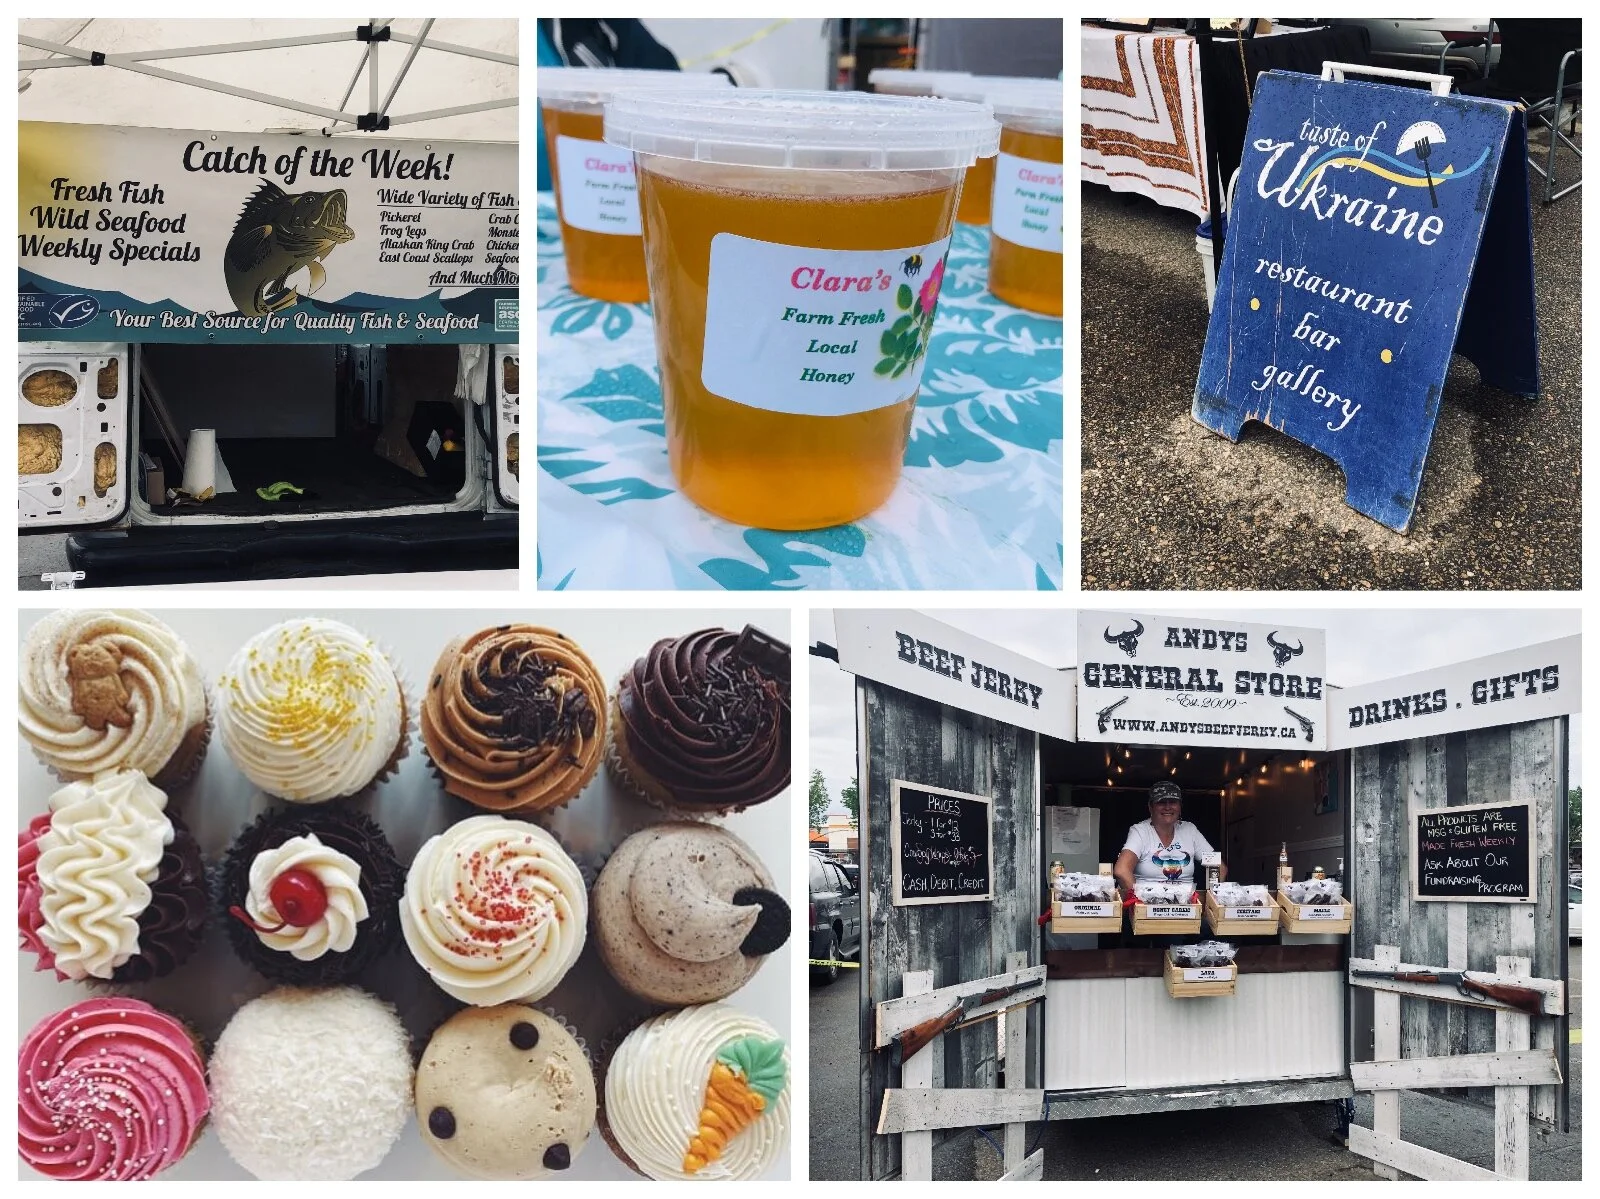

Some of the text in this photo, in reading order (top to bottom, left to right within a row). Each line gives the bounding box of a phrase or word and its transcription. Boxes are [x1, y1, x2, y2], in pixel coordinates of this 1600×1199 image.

[1300, 118, 1386, 172] taste of
[183, 140, 454, 185] Catch of the Week!
[50, 177, 165, 204] Fresh Fish
[377, 188, 514, 210] Wide Variety of Fish
[1253, 138, 1444, 246] Ukraine
[29, 205, 187, 239] Wild Seafood
[380, 210, 421, 223] Pickerel
[488, 213, 512, 225] Crab
[380, 225, 427, 239] Frog Legs
[18, 234, 201, 267] Weekly Specials
[380, 238, 475, 253] Alaskan King Crab
[379, 251, 474, 266] East Coast Scallops
[429, 270, 457, 285] And
[460, 270, 493, 285] Much
[791, 266, 892, 292] Clara's
[1255, 257, 1412, 324] restaurant
[109, 309, 480, 335] Your Best Source for Quality Fish & Seafood
[781, 307, 885, 326] Farm Fresh
[1291, 312, 1341, 351] bar
[806, 339, 858, 354] Local
[800, 367, 855, 385] Honey
[1251, 362, 1362, 432] gallery
[1164, 626, 1248, 652] ANDYS
[896, 630, 1043, 710] BEEF JERKY
[1083, 662, 1323, 700] GENERAL STORE
[1349, 688, 1448, 729] DRINKS
[1471, 664, 1559, 705] GIFTS
[1113, 718, 1297, 739] WWW.ANDYSBEEFJERKY.CA
[928, 794, 961, 813] PRICES
[1421, 811, 1503, 828] ALL PRODUCTS ARE
[1427, 828, 1447, 838] MSG
[1453, 824, 1487, 836] GLUTEN
[1493, 822, 1518, 832] FREE
[1421, 836, 1516, 851] MADE FRESH WEEKLY
[1424, 852, 1508, 870] ASK ABOUT OUR
[958, 872, 984, 891] CREDIT
[1425, 872, 1482, 886] FUNDRAISING
[1478, 883, 1523, 893] PROGRAM
